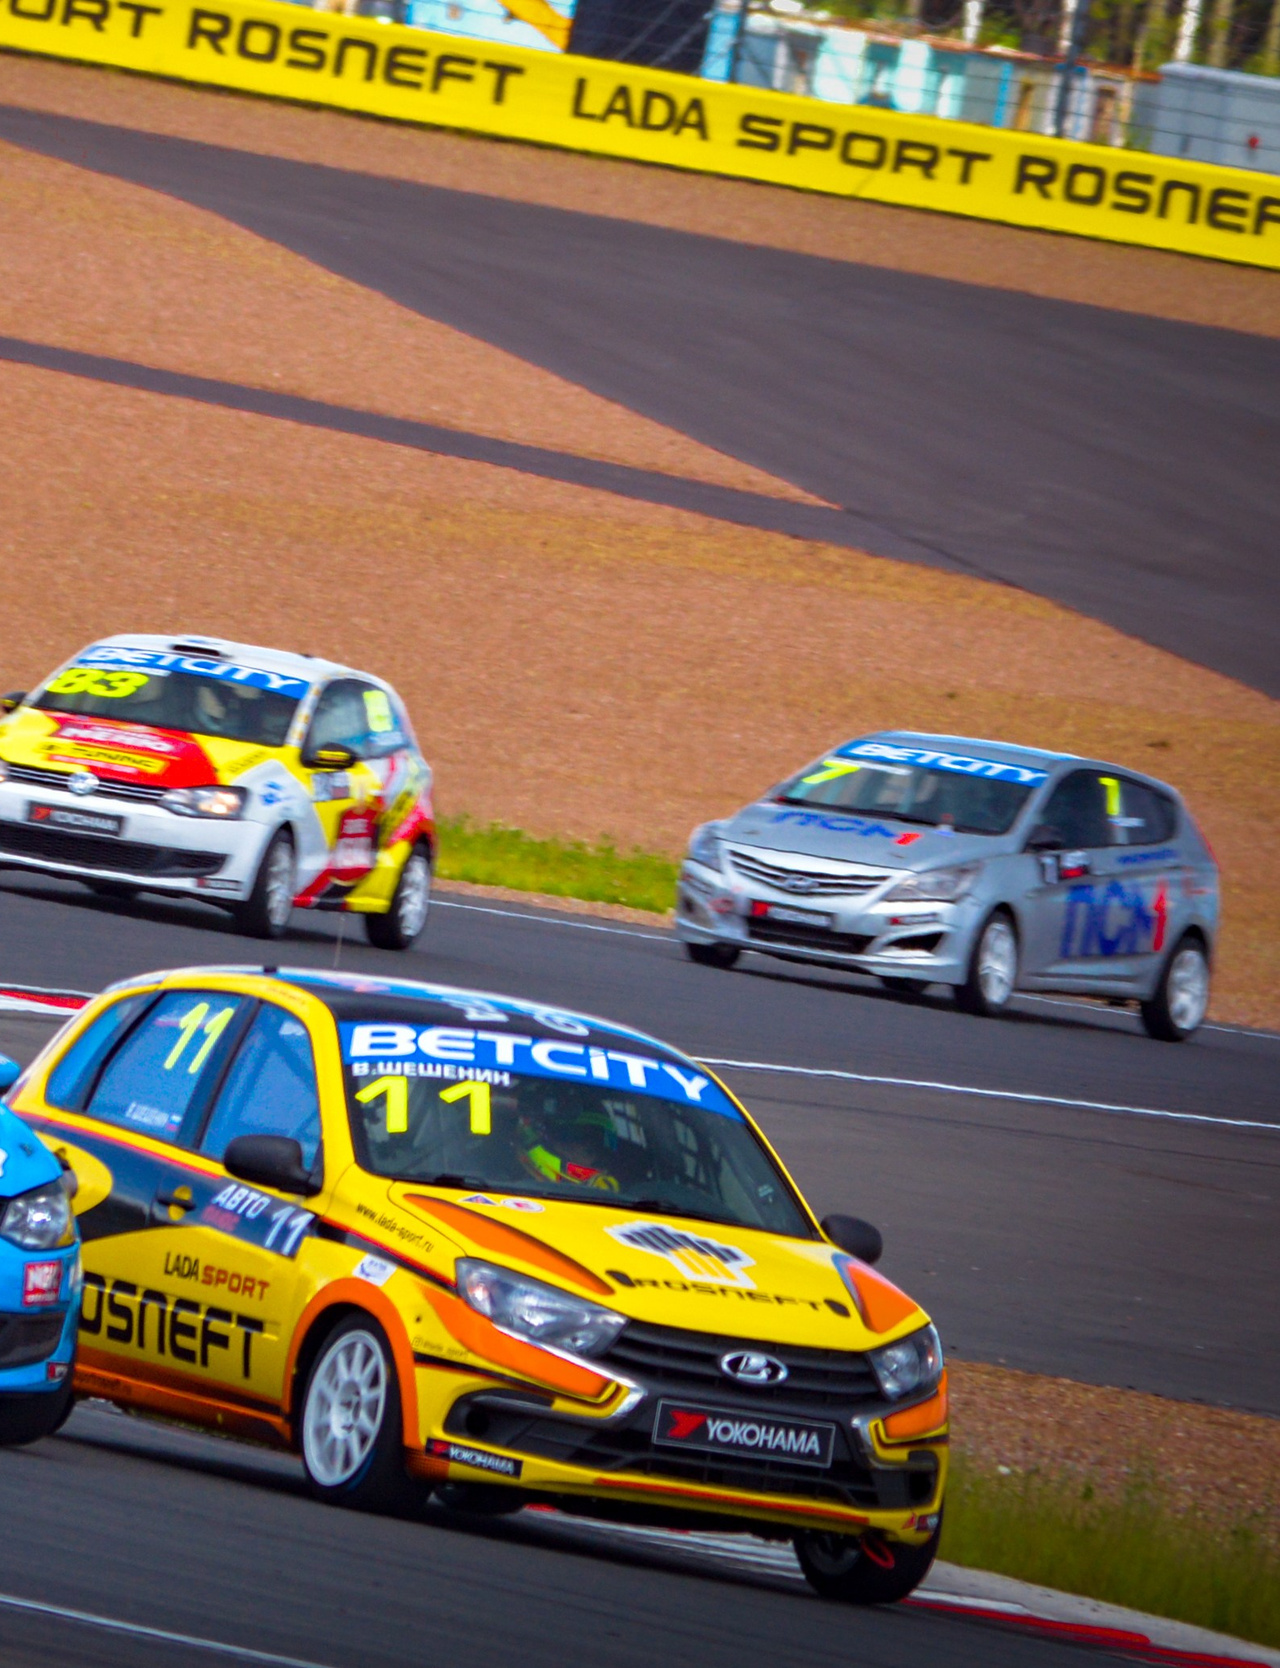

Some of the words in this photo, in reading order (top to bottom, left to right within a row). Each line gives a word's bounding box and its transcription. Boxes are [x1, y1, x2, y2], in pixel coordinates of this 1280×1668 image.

[186, 9, 525, 106] ROSNEFT
[572, 77, 711, 141] LADA
[736, 113, 993, 187] SPORT
[45, 667, 149, 698] 83
[85, 648, 303, 689] BETCITY
[802, 760, 861, 785] 7
[849, 743, 1050, 782] BETCITY
[163, 1002, 235, 1074] 11
[350, 1023, 710, 1102] BETCITY
[352, 1061, 511, 1088] В.ШЕШЕНИН
[355, 1074, 491, 1135] 11
[213, 1183, 270, 1220] АВТО
[264, 1205, 315, 1256] 11
[356, 1202, 435, 1253] www.lada-sport.ru
[164, 1251, 200, 1282] LADA
[201, 1264, 270, 1301] SPORT
[634, 1277, 822, 1312] ROSNEFT
[706, 1416, 821, 1456] YOKOHAMA
[449, 1445, 515, 1476] YOKOHAMA
